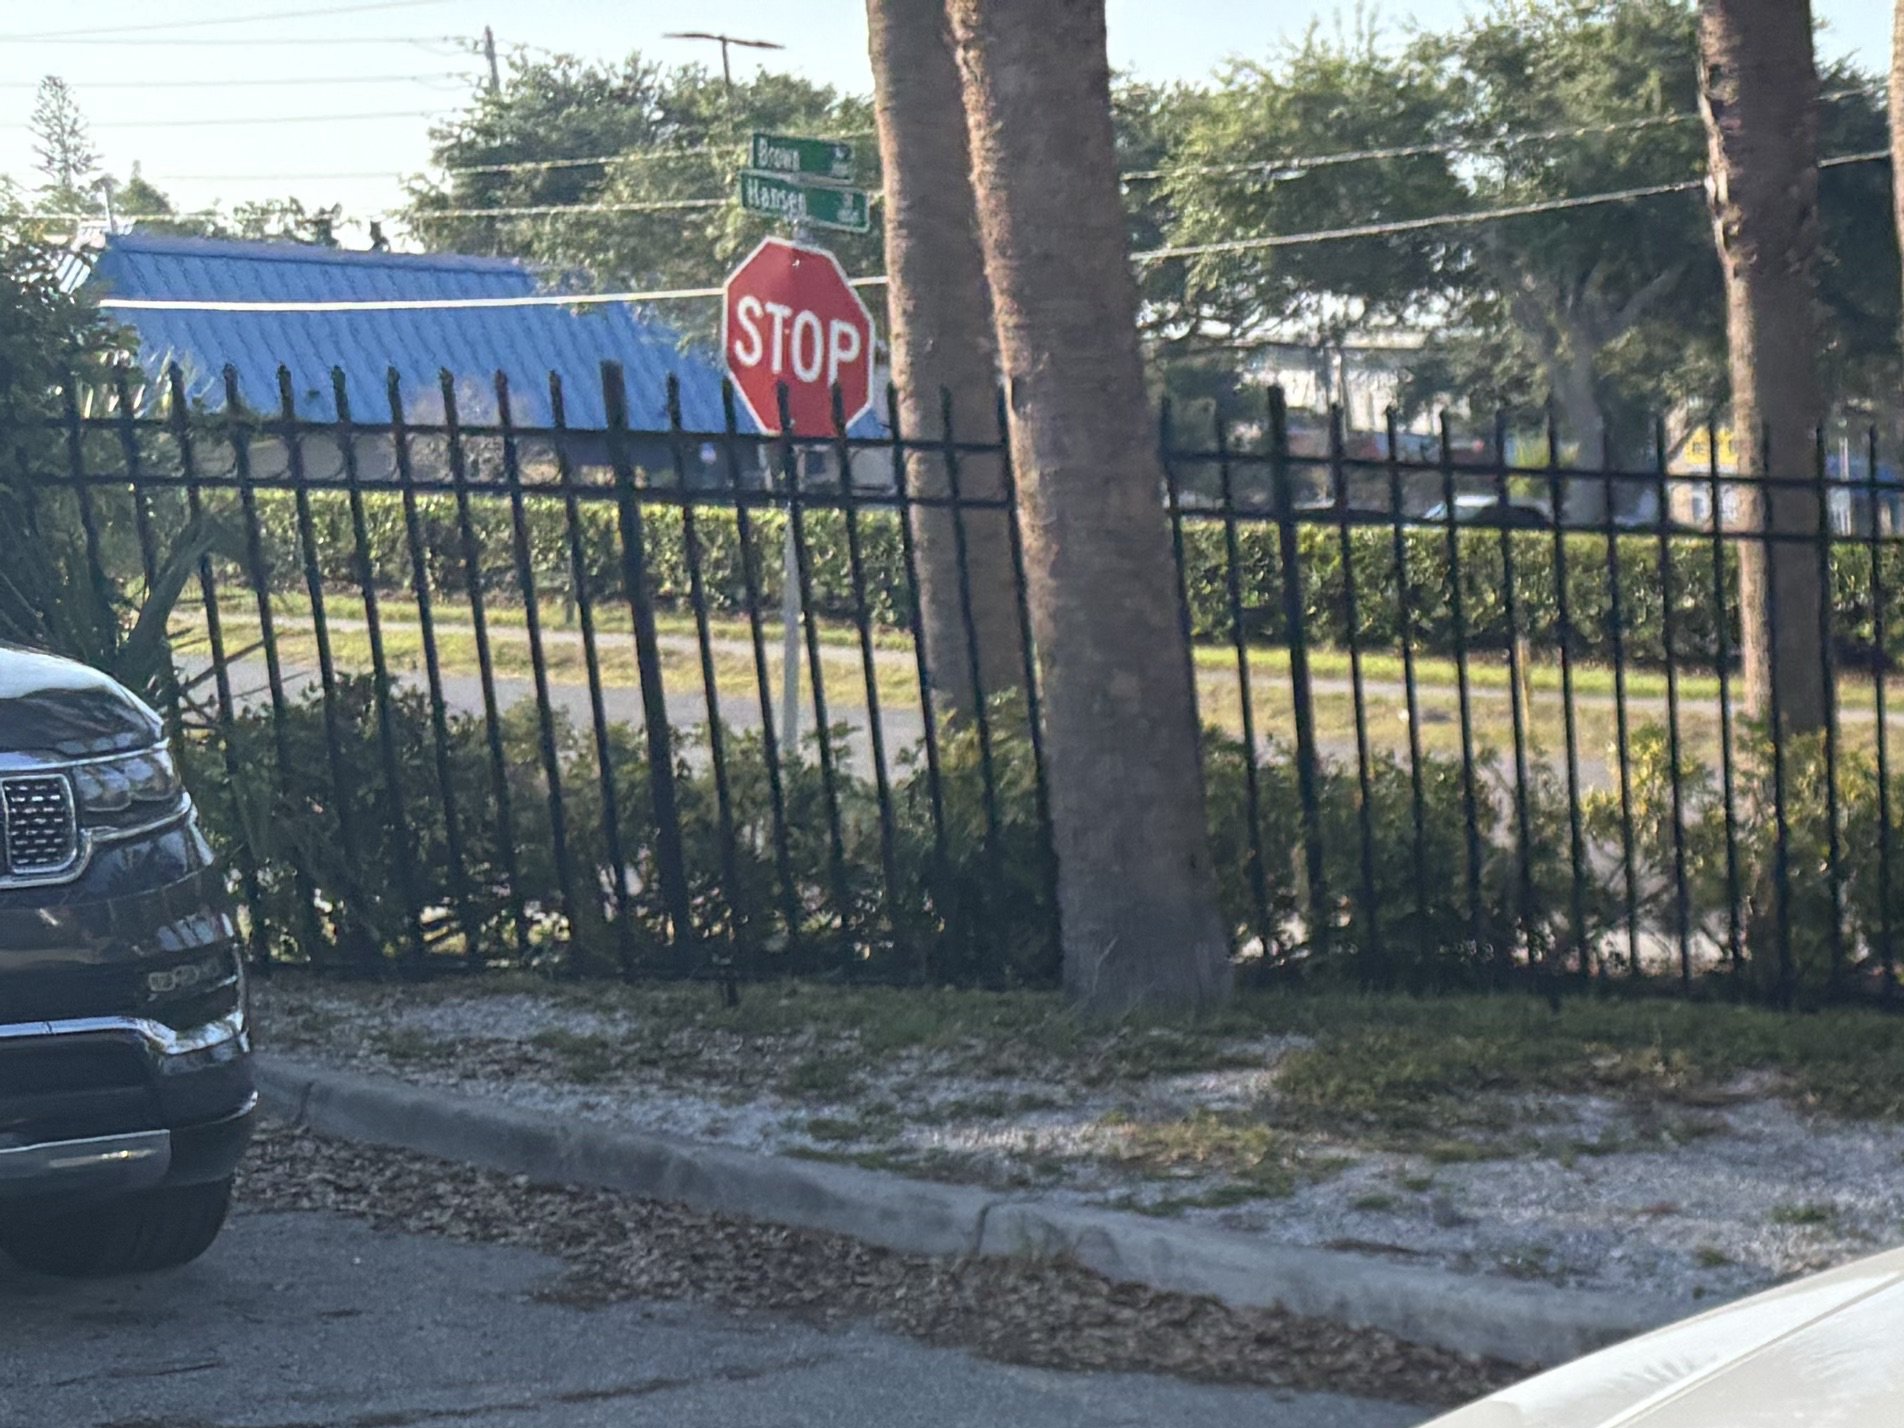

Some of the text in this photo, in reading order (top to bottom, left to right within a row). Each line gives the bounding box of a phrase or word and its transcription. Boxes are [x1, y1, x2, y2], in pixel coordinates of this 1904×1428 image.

[757, 137, 801, 172] Brown
[746, 177, 808, 219] Hansen
[734, 295, 861, 388] STOP
